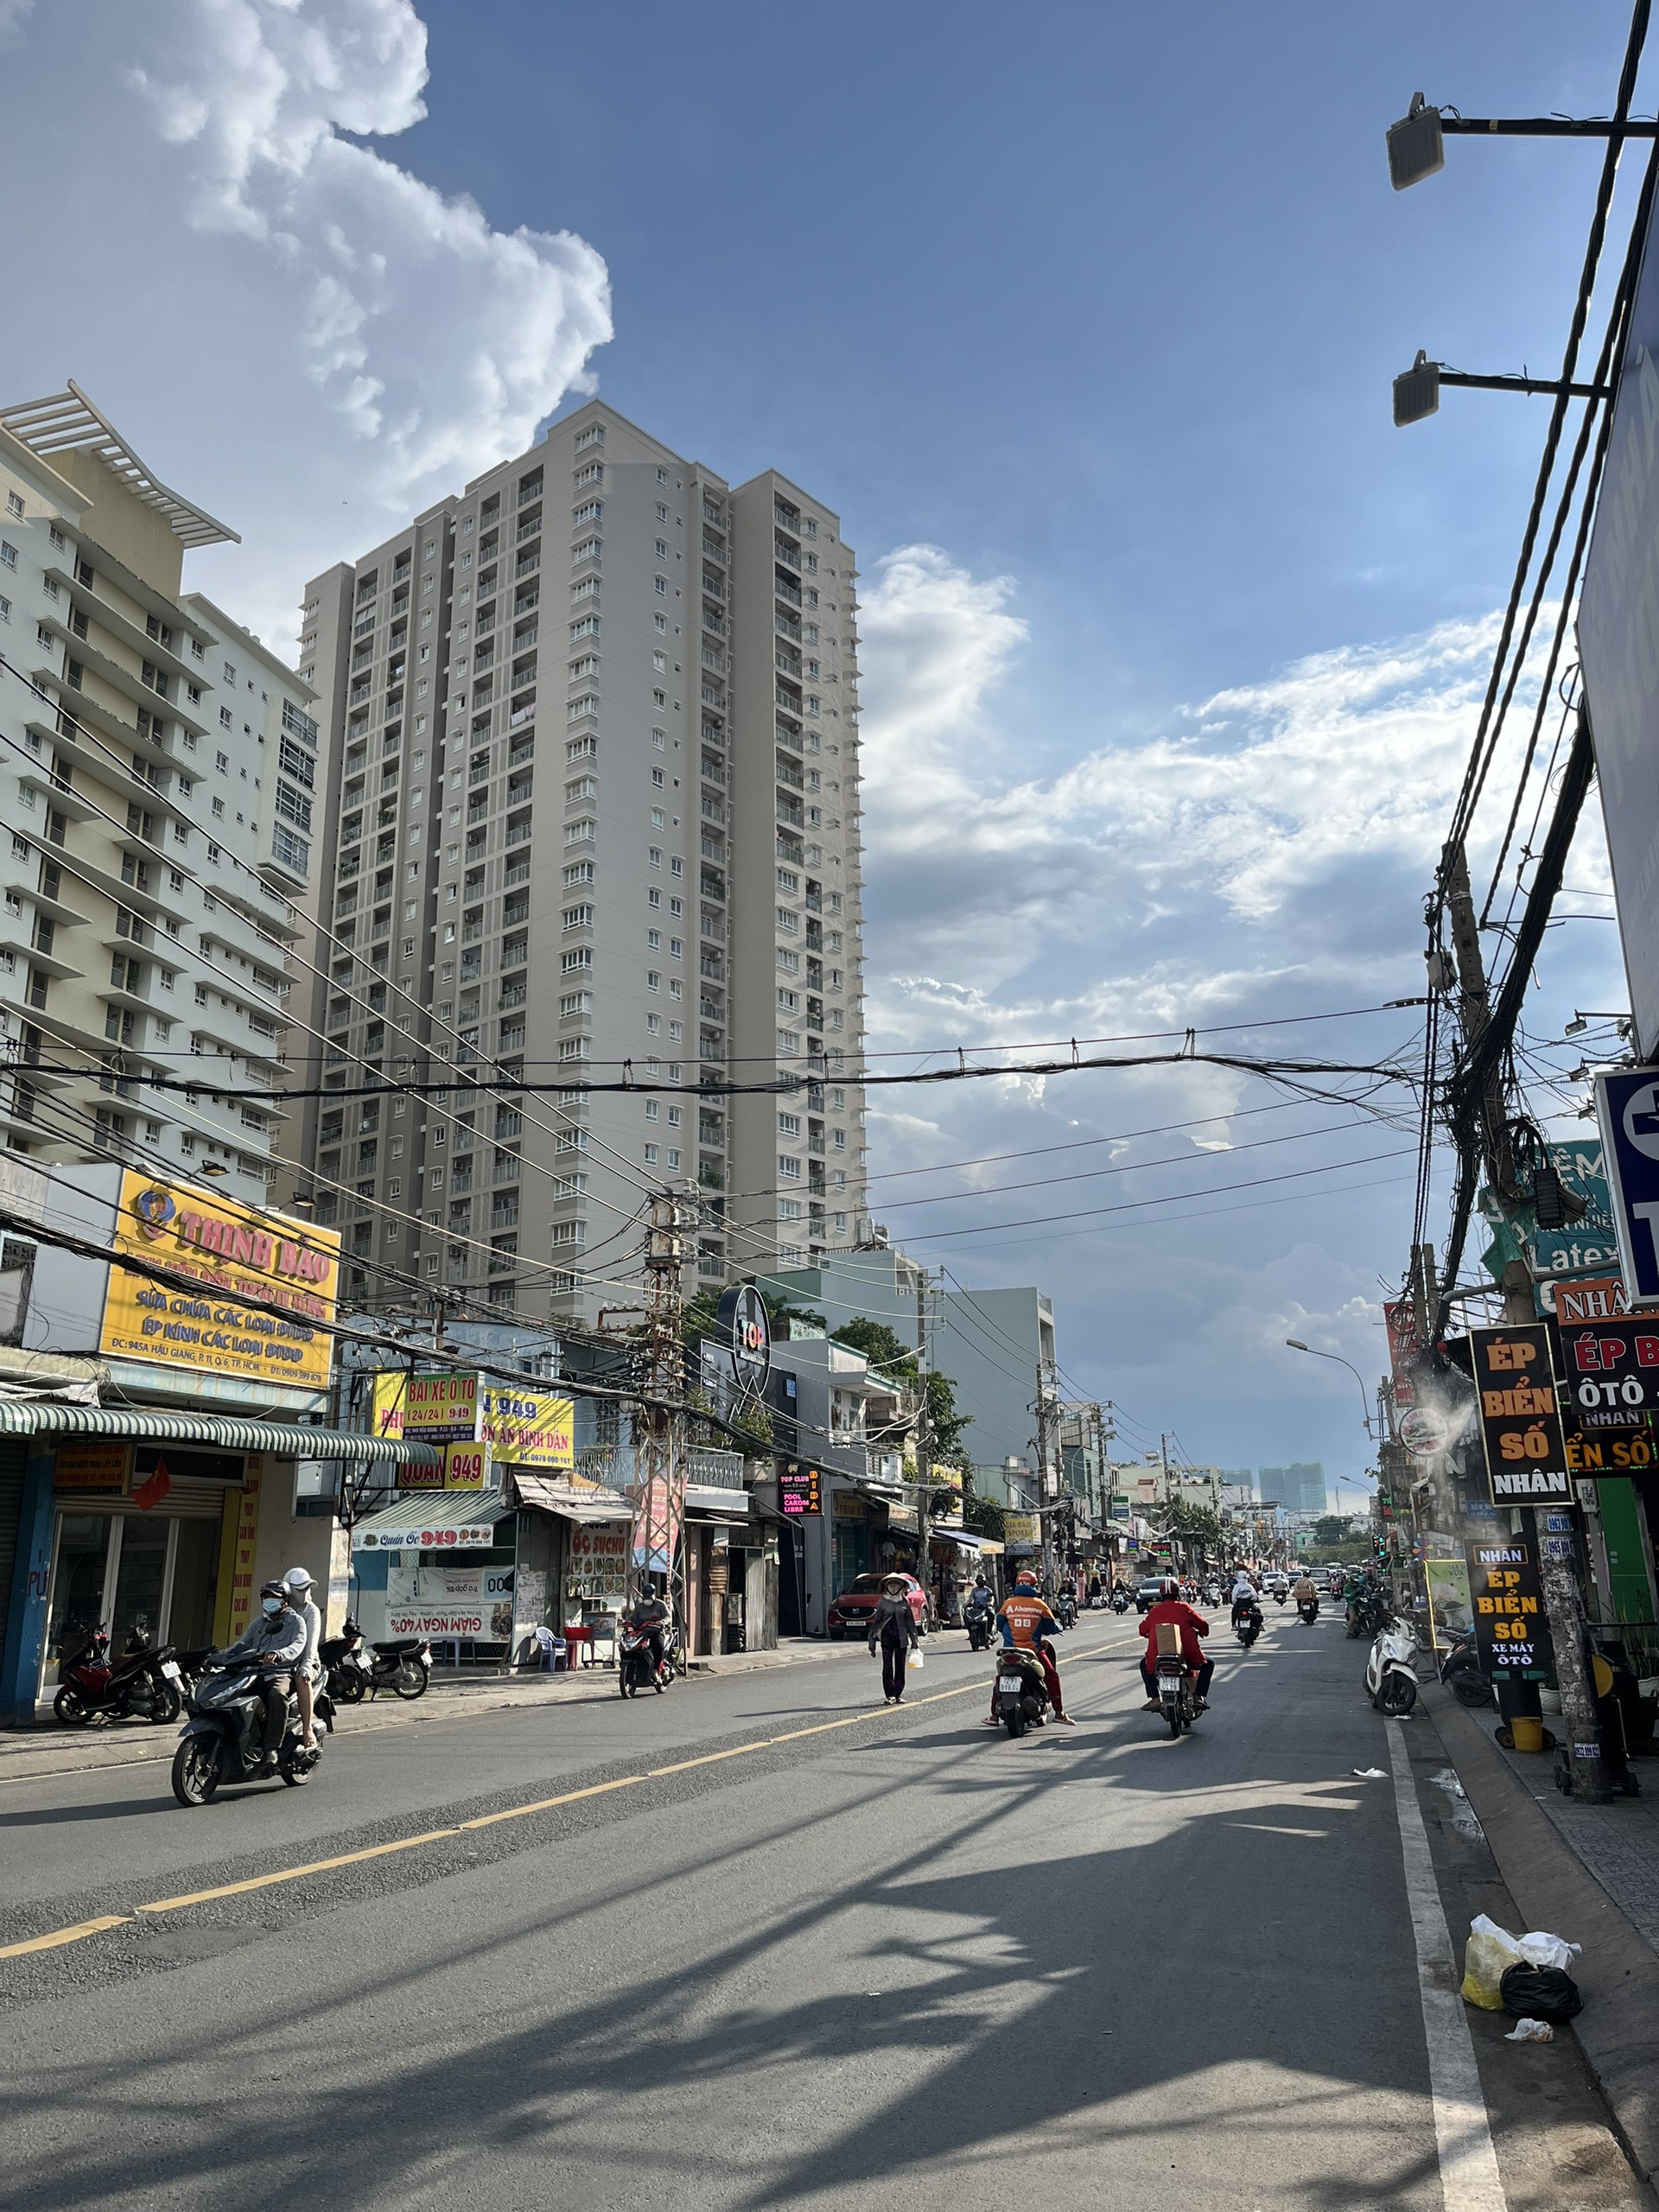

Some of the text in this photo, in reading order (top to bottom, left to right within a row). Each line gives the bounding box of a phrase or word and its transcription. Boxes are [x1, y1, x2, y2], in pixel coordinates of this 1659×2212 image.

[180, 1211, 275, 1269] THỊNH
[171, 1293, 212, 1322] CHỮA
[214, 1302, 243, 1328] CÁC
[1560, 1281, 1656, 1319] NHÂ
[142, 1315, 163, 1337] ÉP
[164, 1322, 201, 1345] KÍNH
[202, 1329, 232, 1351] CÁC
[232, 1336, 264, 1359] LOẠI
[738, 1319, 766, 1351] TOP
[128, 1341, 149, 1352] 945A
[151, 1344, 168, 1357] HẬU
[170, 1348, 198, 1363] GIANG,
[243, 1362, 259, 1372] HCM
[1486, 1337, 1536, 1372] ÉP
[1573, 1332, 1659, 1372] ÉP B
[409, 1375, 475, 1403] BÃI XE Ô TÔ
[1482, 1376, 1554, 1417] BIỂN
[1578, 1374, 1645, 1408] ÔTÔ
[448, 1408, 470, 1419] 949
[498, 1396, 537, 1420] 949
[518, 1424, 543, 1447] BÌNH
[546, 1432, 569, 1450] DÂN
[1499, 1420, 1549, 1460] SỐ
[1566, 1430, 1650, 1469] ỂN SỐ
[450, 1453, 482, 1482] 949
[531, 1453, 548, 1463] 0979
[1493, 1468, 1567, 1495] NHÂN
[380, 1529, 457, 1546] Quán Ốc 949
[593, 1535, 626, 1555] SUCHU
[1479, 1548, 1522, 1562] NHÂN
[1486, 1567, 1521, 1588] ÉP
[1014, 1605, 1042, 1614] Ahamove
[1477, 1588, 1538, 1614] BIỂN
[391, 1618, 481, 1636] GIẢM NGAY 40%
[1494, 1615, 1528, 1640] SỐ
[1491, 1641, 1535, 1653] XE MÁY
[1497, 1654, 1533, 1665] ÔTÔ
